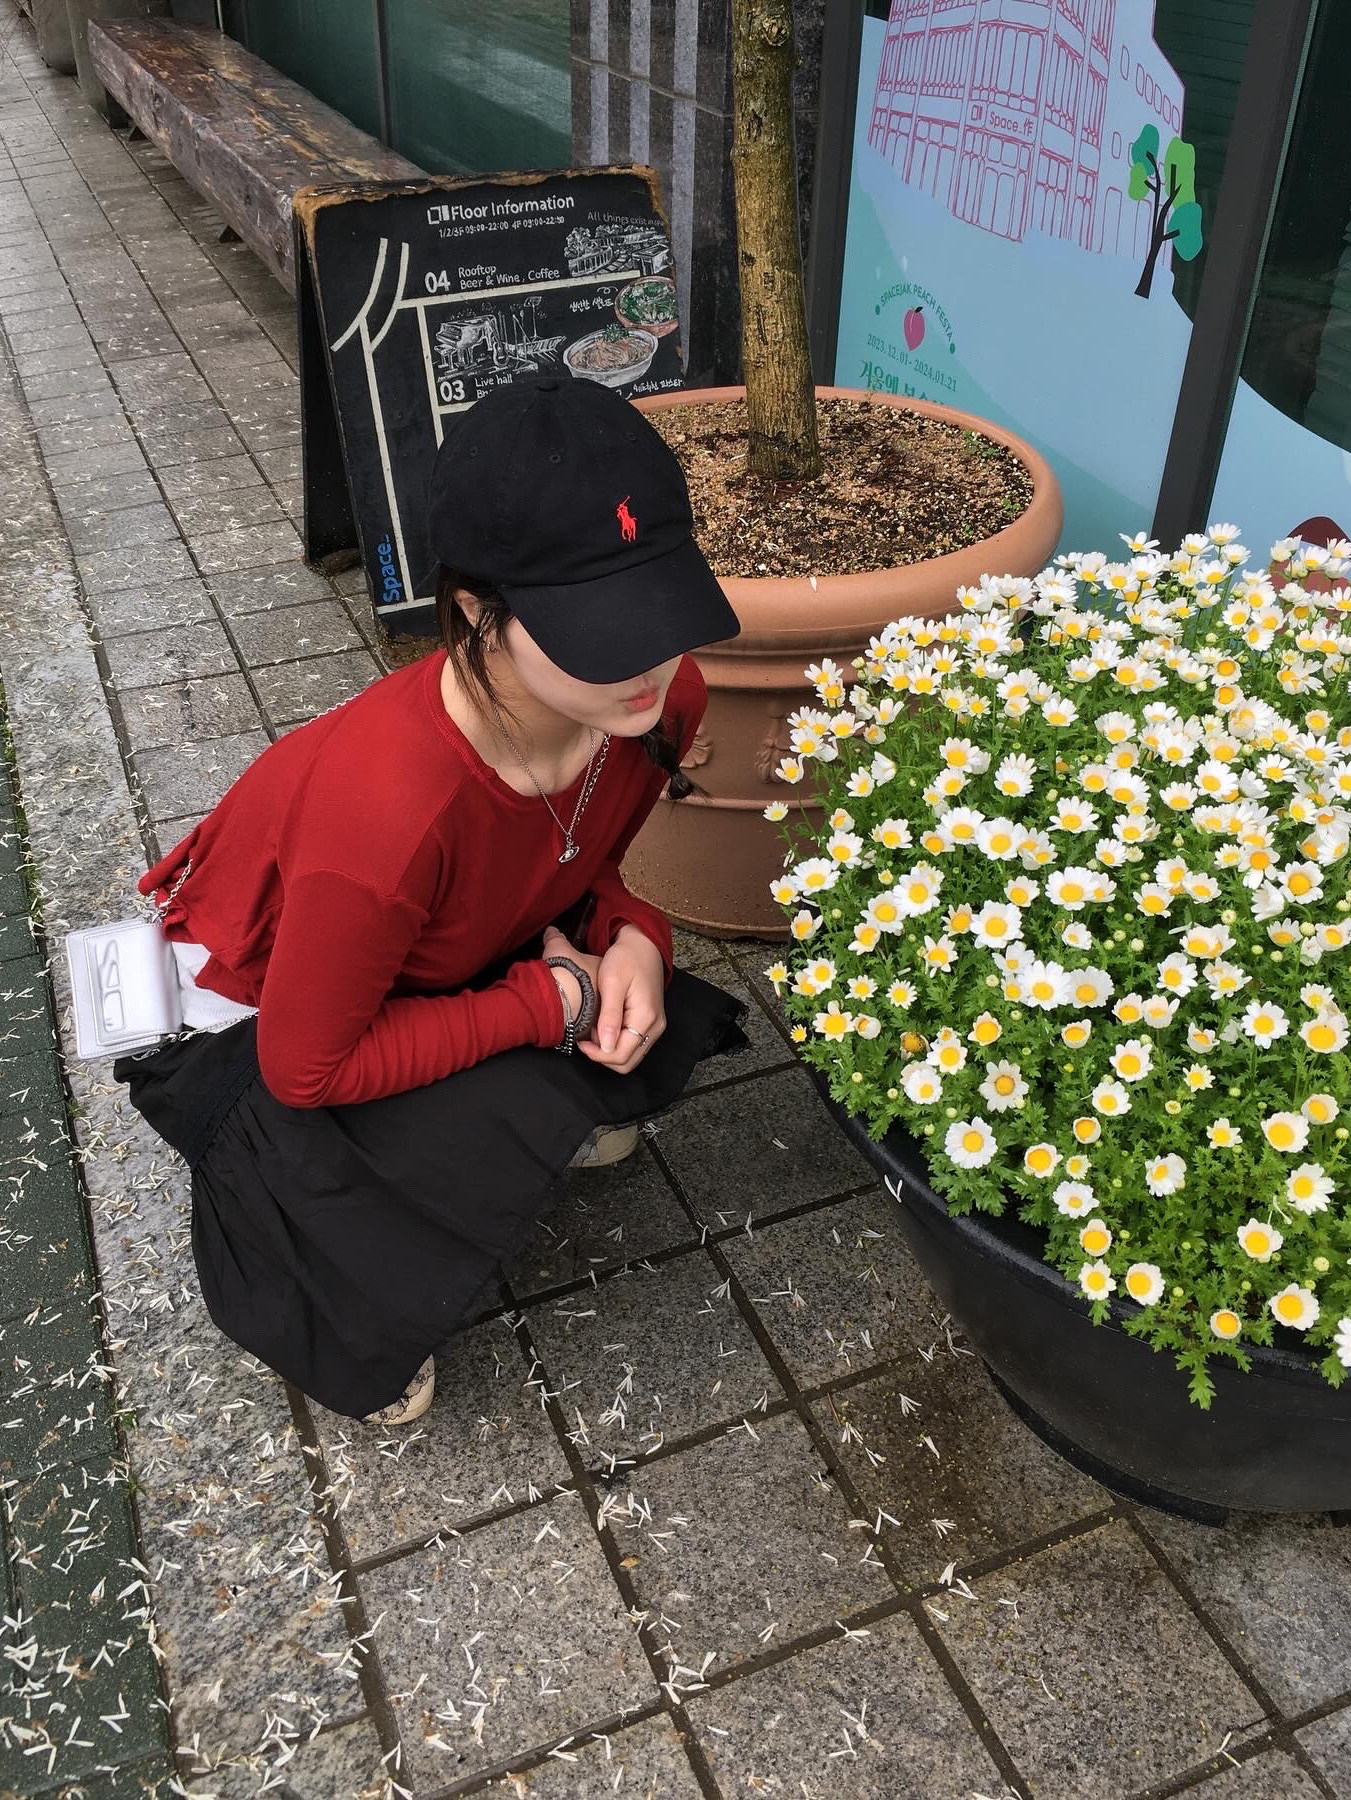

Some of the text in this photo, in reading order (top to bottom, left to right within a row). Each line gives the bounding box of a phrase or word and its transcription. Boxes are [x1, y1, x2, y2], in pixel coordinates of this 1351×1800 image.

[451, 194, 575, 221] Floor Information
[587, 211, 600, 221] All
[603, 212, 629, 226] things
[512, 220, 521, 230] 4F
[424, 269, 450, 293] 04
[458, 264, 497, 278] Rooftop
[460, 278, 483, 290] Beer
[485, 275, 495, 286] &
[527, 268, 560, 281] Coffee
[881, 283, 953, 342] SPACEJAK PEACH FESTA
[440, 380, 466, 402] 03
[474, 373, 513, 387] Live hall
